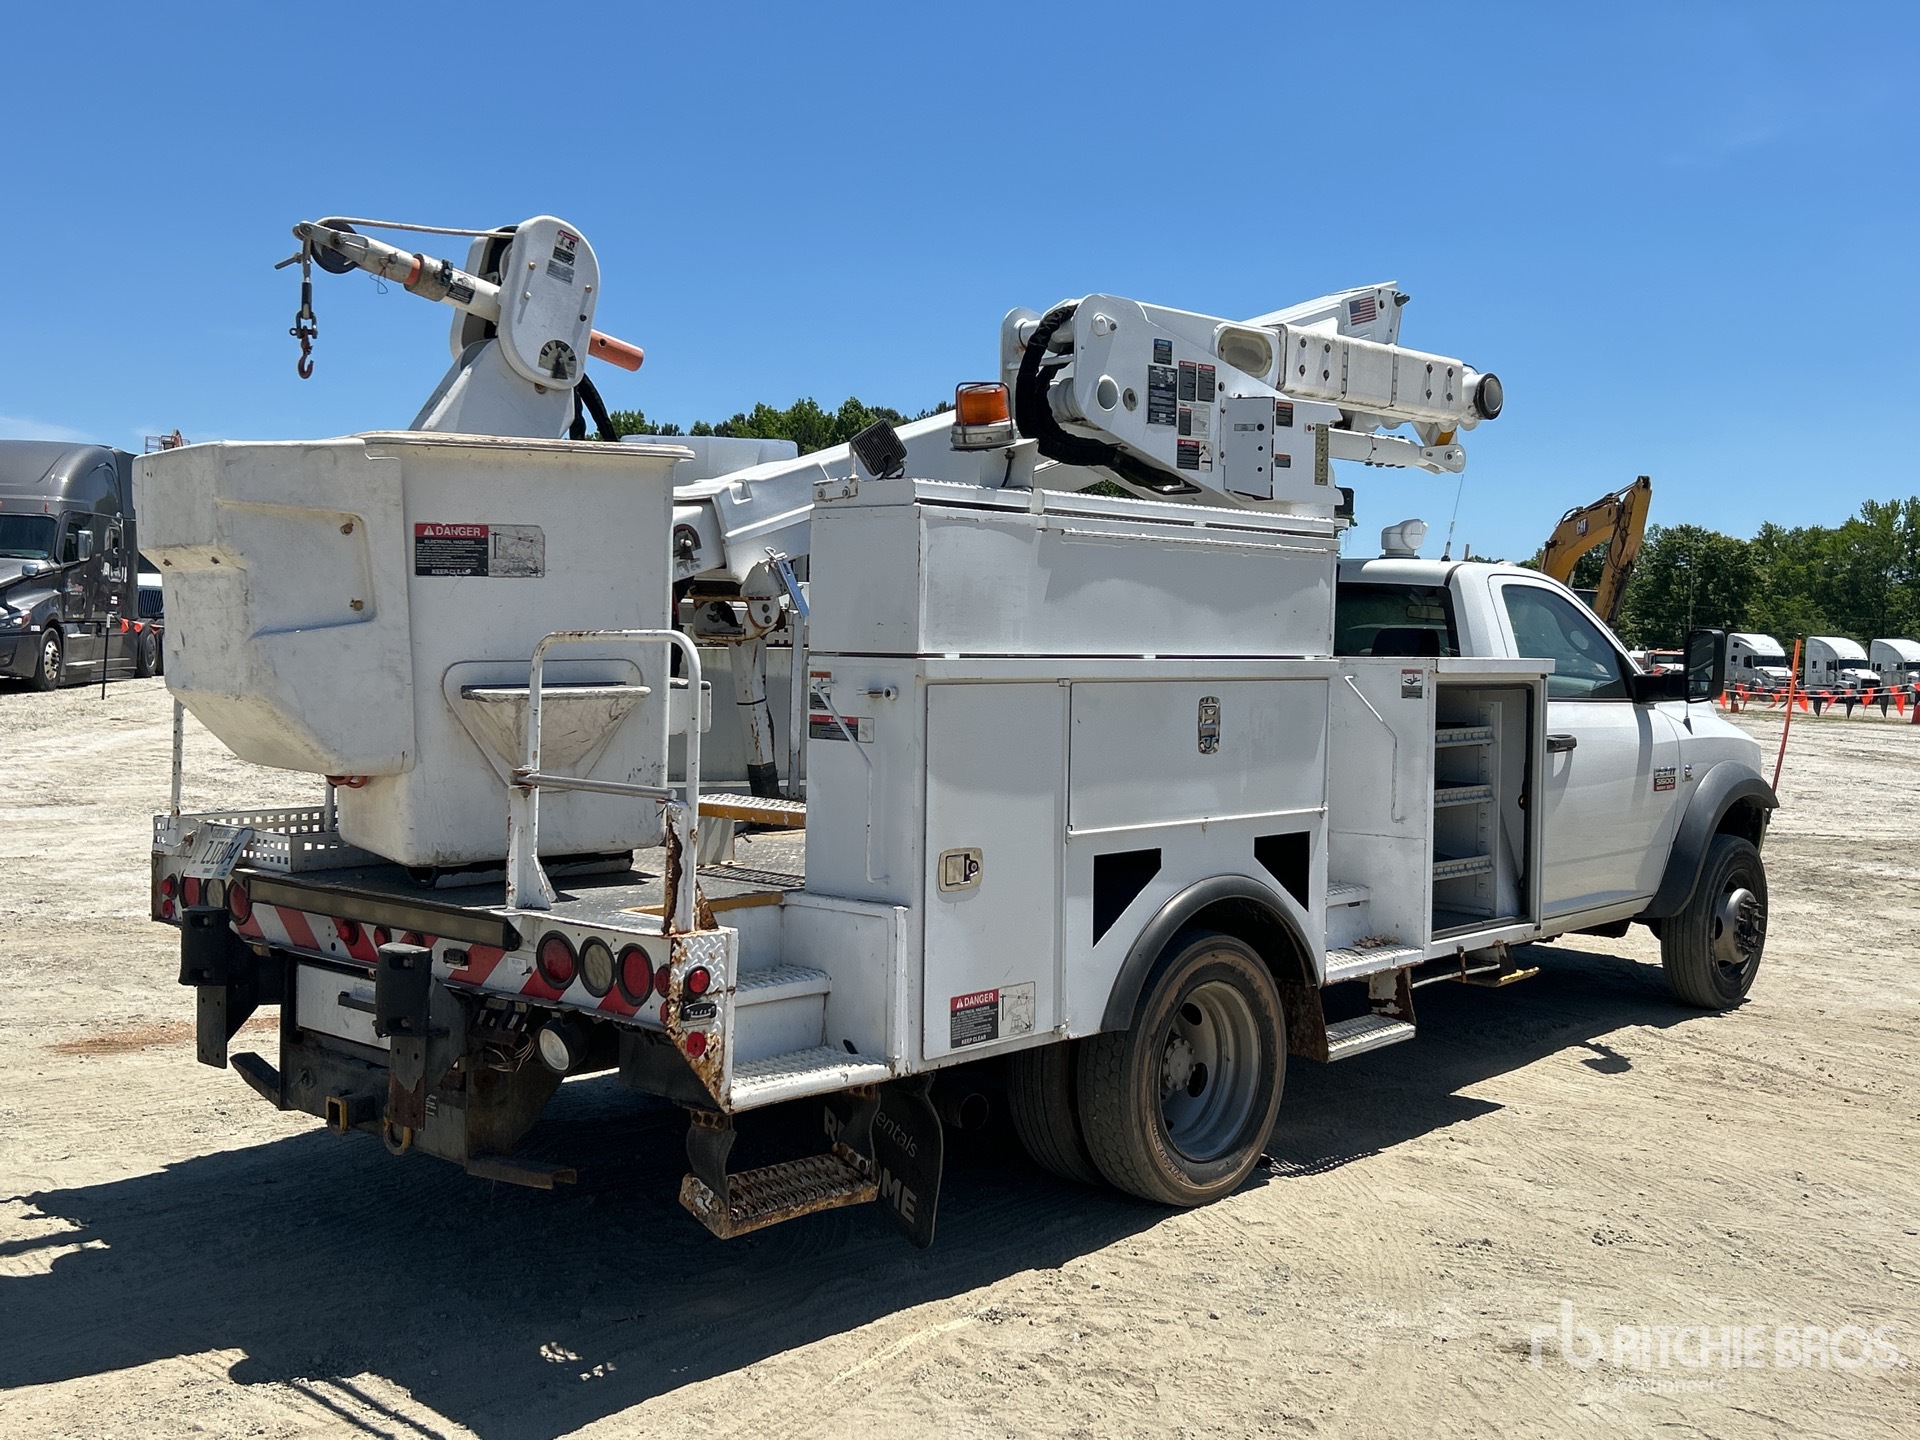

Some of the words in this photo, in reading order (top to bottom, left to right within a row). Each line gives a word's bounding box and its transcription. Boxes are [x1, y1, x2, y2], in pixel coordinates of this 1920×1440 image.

[436, 526, 480, 536] DANGER
[964, 993, 994, 1006] DANGER
[881, 1167, 917, 1224] ME
